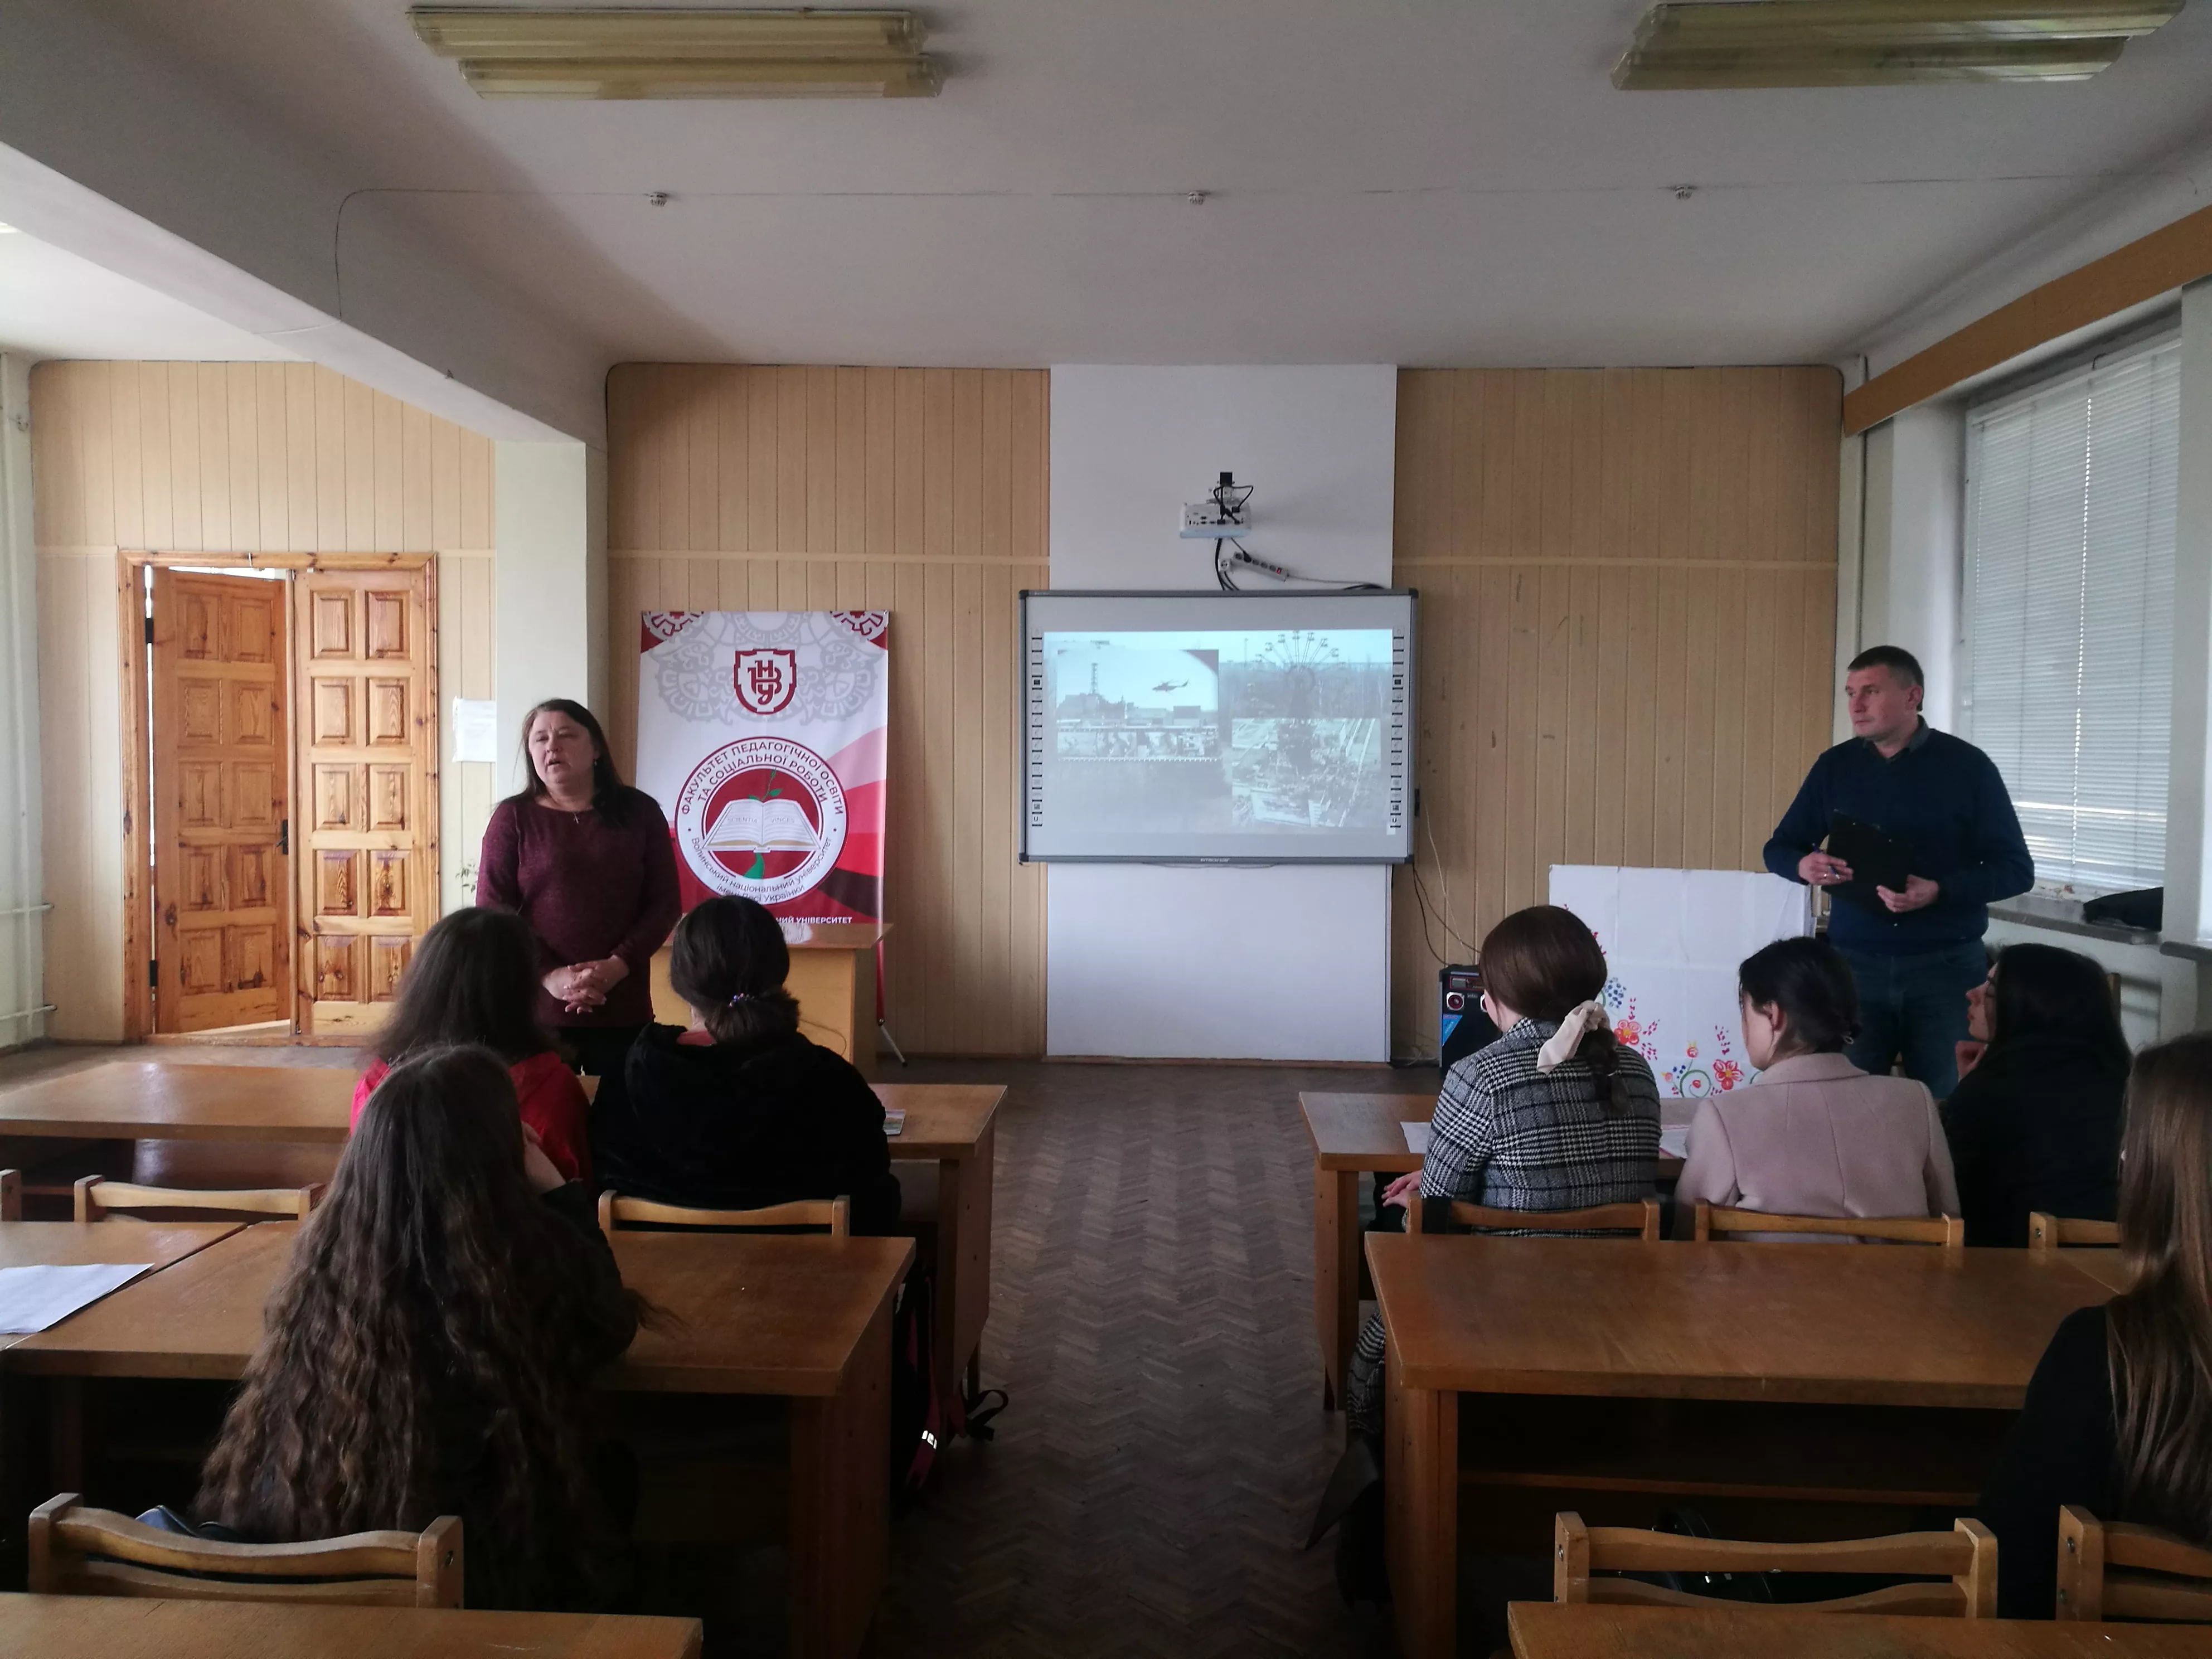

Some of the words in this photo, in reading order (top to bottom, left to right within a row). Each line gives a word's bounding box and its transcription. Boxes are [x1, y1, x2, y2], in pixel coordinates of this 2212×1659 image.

[681, 751, 729, 814] ФАКУЛЬТЕТ
[731, 741, 824, 771] ПЕДАГОГІЧНОЇ
[820, 770, 843, 814] ОСВІТИ
[697, 788, 711, 802] ТА
[709, 754, 789, 785] СОЦІАЛЬНОЇ
[789, 760, 828, 802] РОБОТИ
[691, 837, 729, 884] Волинський
[730, 877, 795, 893] національний
[795, 837, 832, 885] університет
[764, 885, 804, 902] Українки
[796, 916, 852, 924] УНІВЕРСИТЕТ
